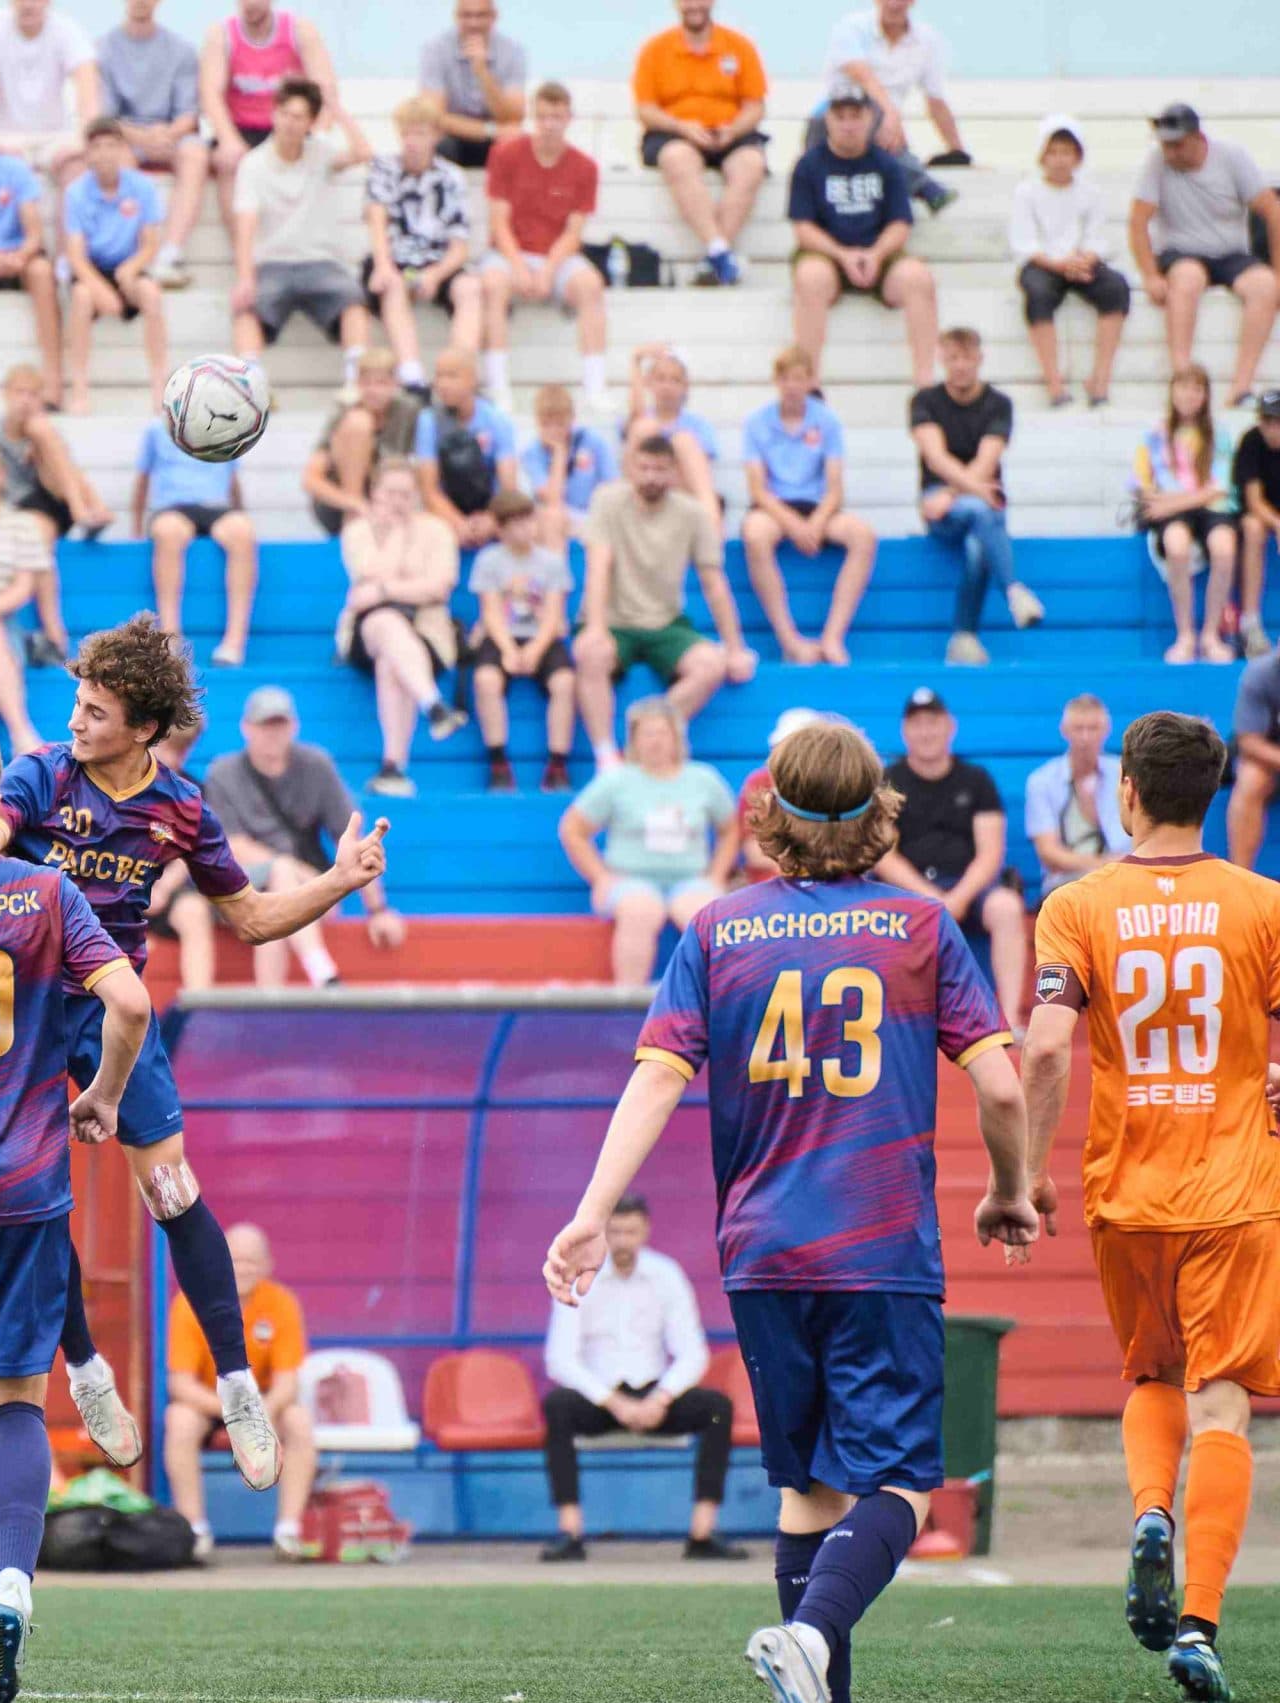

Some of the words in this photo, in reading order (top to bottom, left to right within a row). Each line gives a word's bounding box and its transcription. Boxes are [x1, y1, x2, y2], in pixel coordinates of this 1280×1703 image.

[715, 909, 908, 946] КРАСНОЯРСК
[1116, 901, 1220, 941] ВОРОНА
[748, 966, 884, 1098] 43
[1116, 945, 1224, 1075] 23
